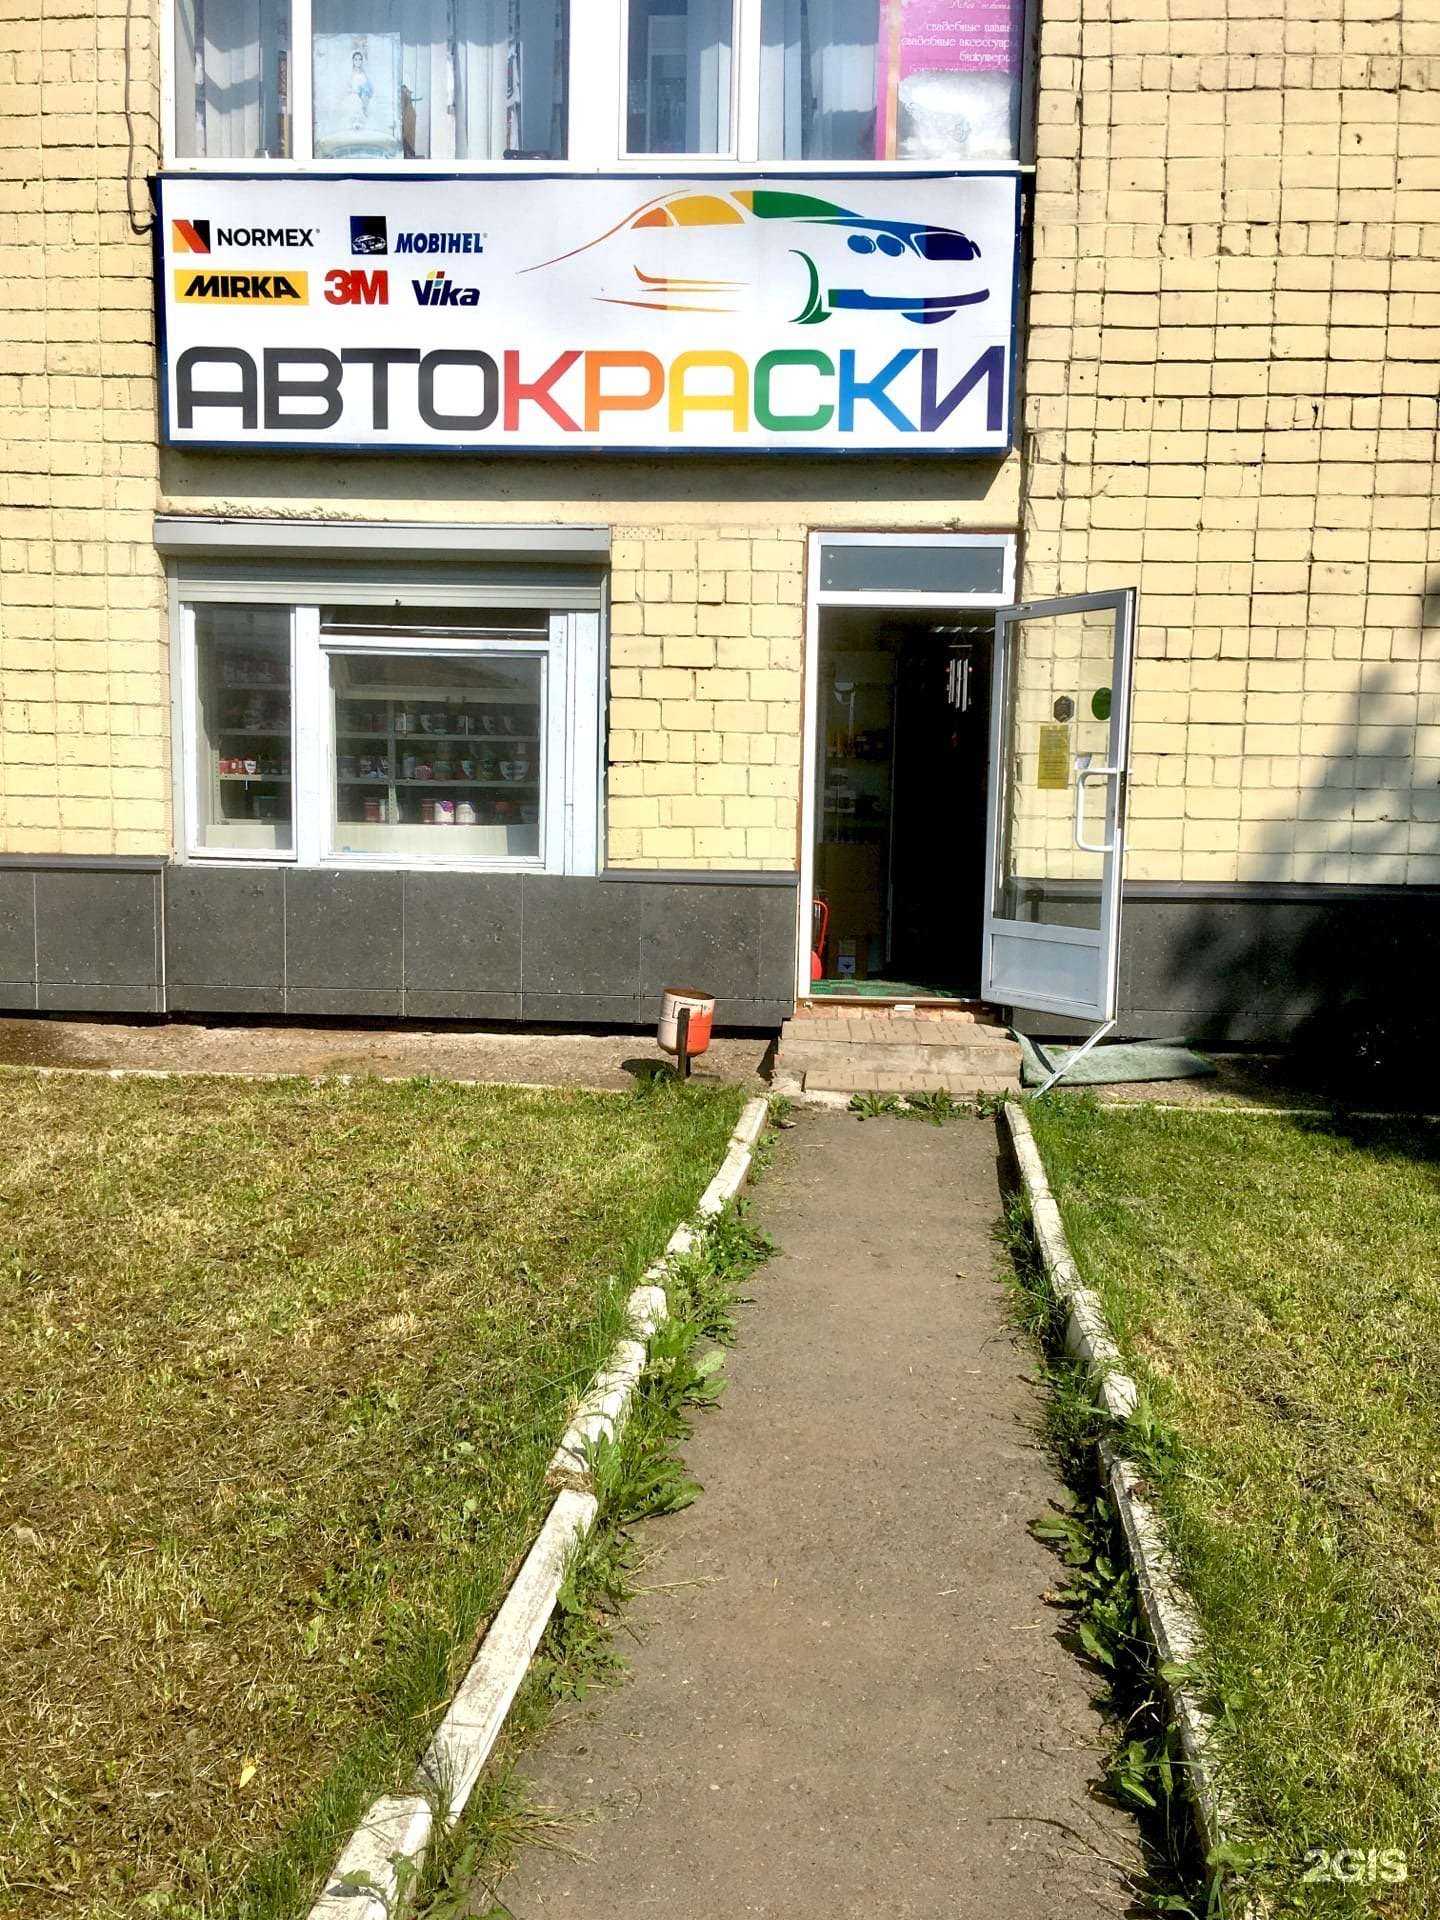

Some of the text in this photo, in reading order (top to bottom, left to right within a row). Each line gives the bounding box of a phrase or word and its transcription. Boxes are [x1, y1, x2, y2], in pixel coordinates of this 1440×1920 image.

[217, 228, 314, 247] NORMEX
[394, 233, 483, 253] MOBIHEL
[184, 275, 301, 298] MIRKA
[324, 269, 389, 305] 3M
[411, 271, 480, 306] Vika
[176, 346, 1005, 432] АВТОКРАСКИ
